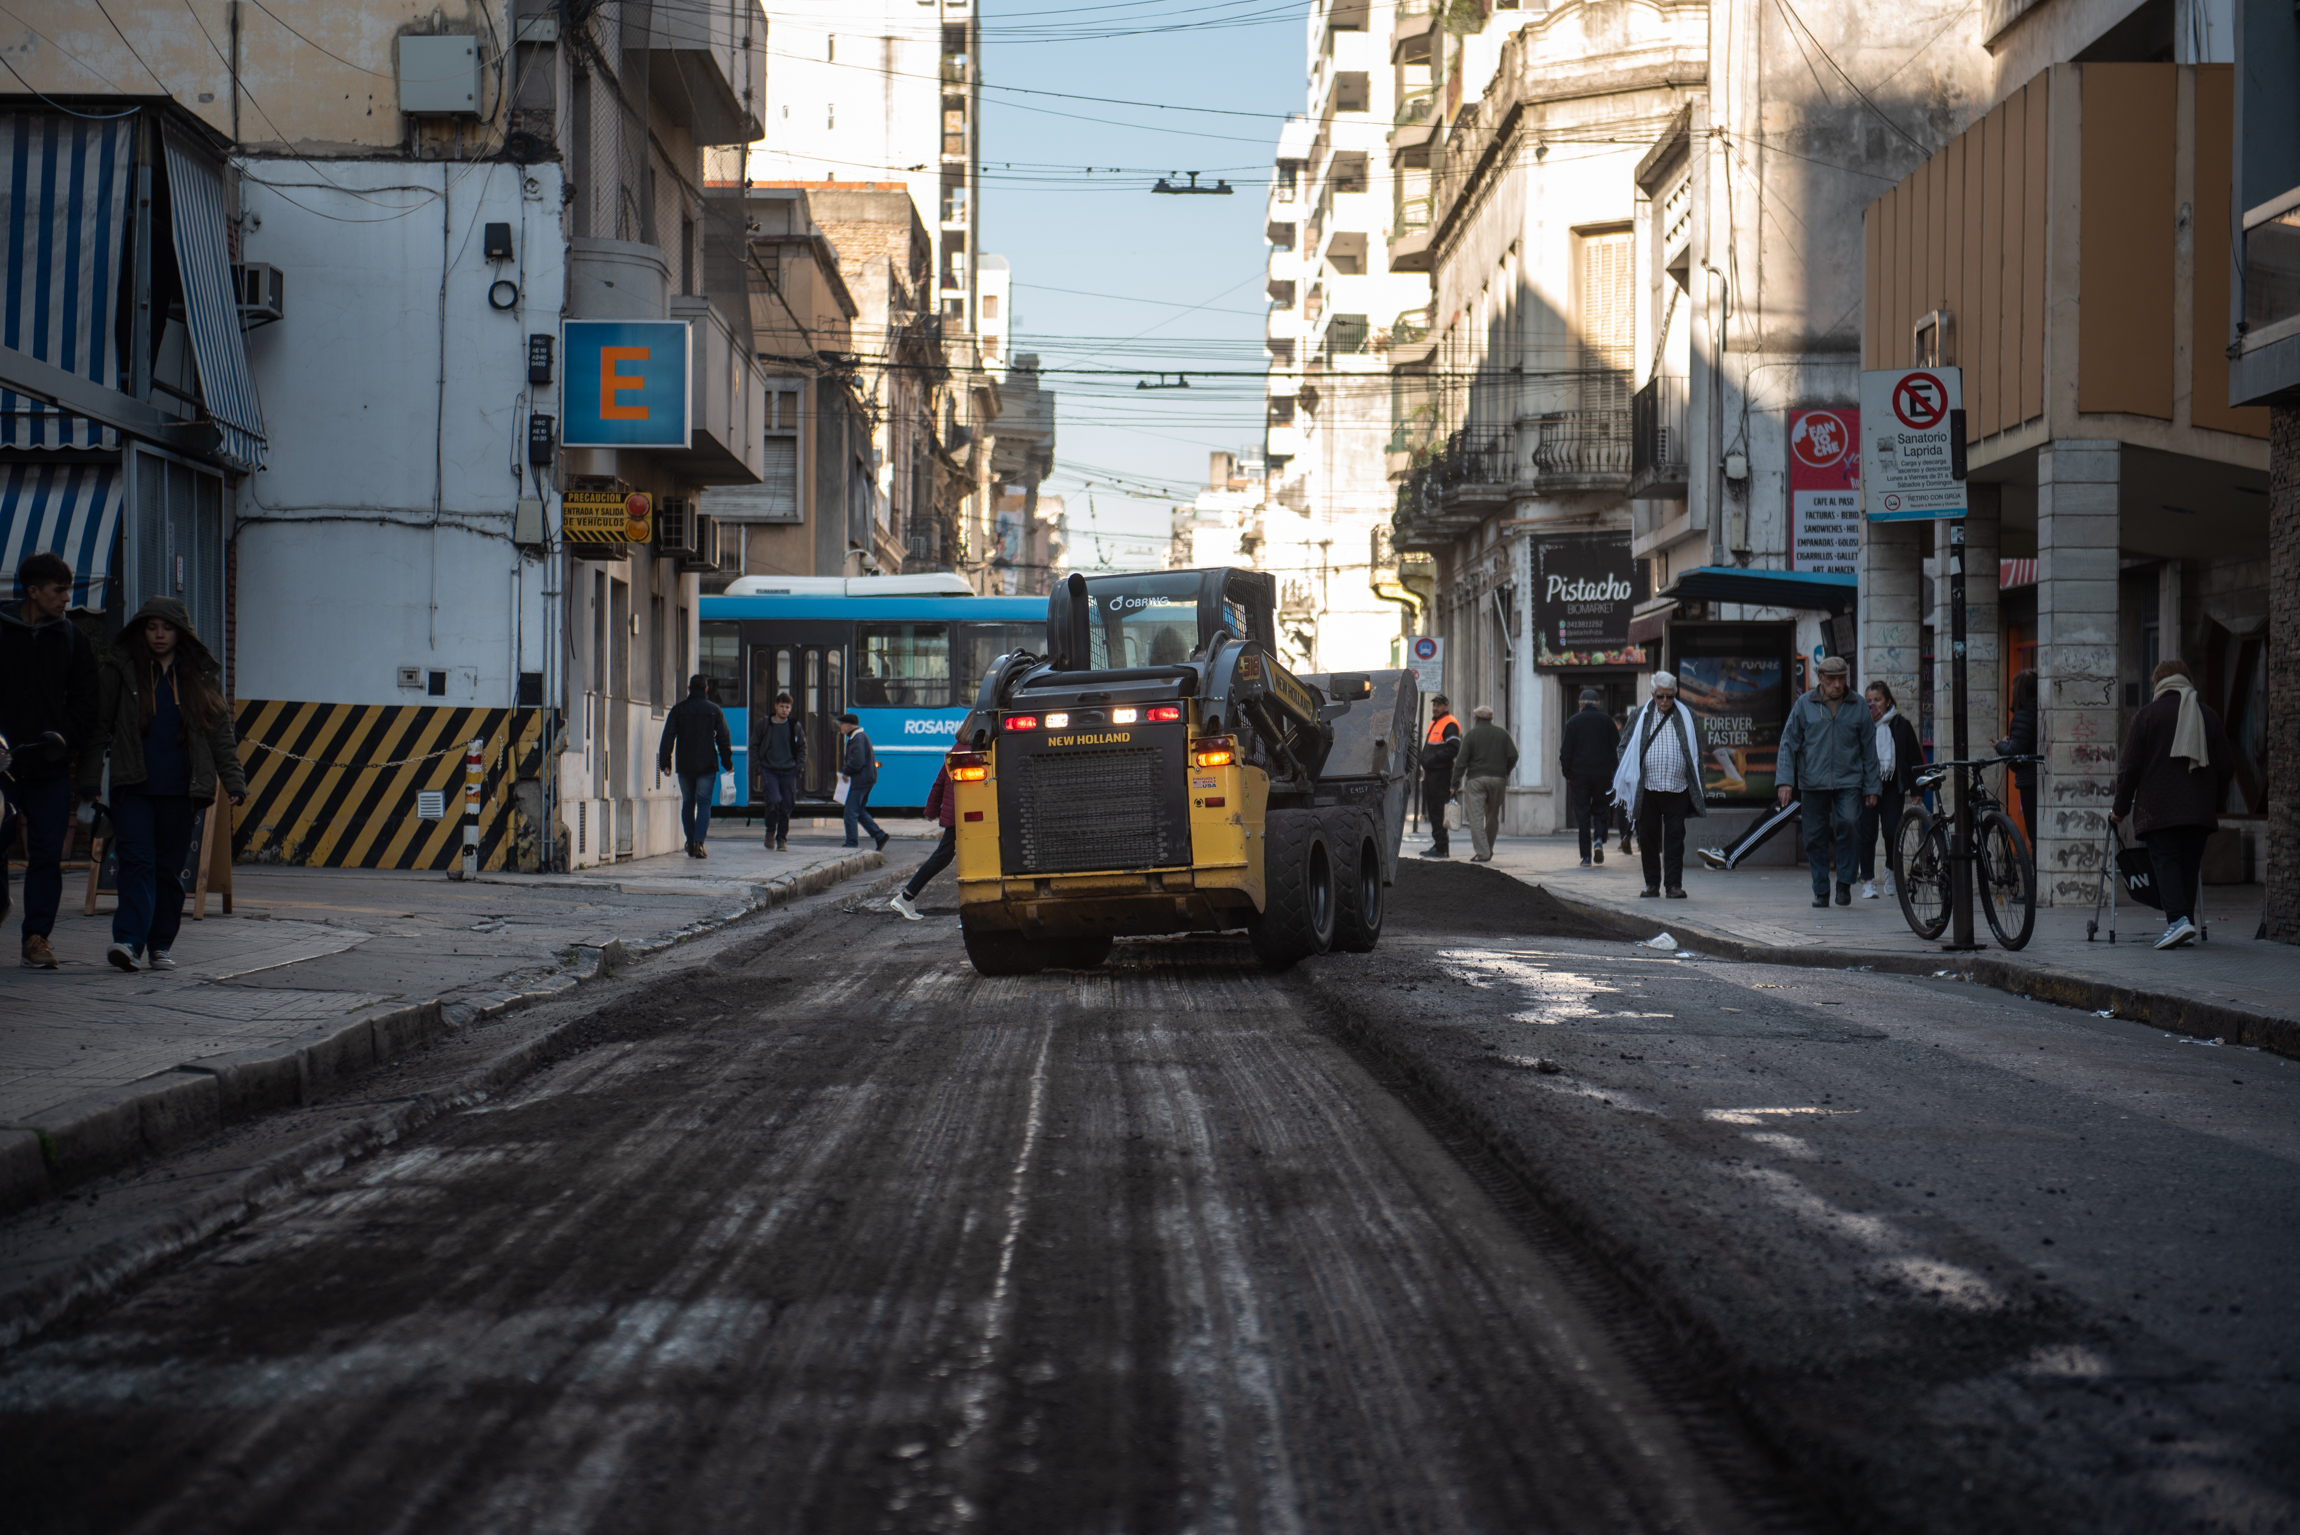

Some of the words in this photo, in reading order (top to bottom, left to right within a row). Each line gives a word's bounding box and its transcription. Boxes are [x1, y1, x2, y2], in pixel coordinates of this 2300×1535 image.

[600, 346, 650, 419] E
[1808, 421, 1837, 438] FAN
[1812, 434, 1831, 447] TO
[1898, 432, 1947, 444] Sanatorio
[1814, 441, 1840, 457] CHE
[1904, 445, 1943, 458] Laprida
[568, 493, 621, 502] PRECAUCION
[1813, 497, 1828, 506] CAFE
[1829, 497, 1837, 506] AL
[1838, 497, 1854, 506] PASO
[563, 507, 593, 516] ENTRADA
[595, 508, 600, 516] Y
[601, 508, 625, 516] SALIDA
[1805, 511, 1835, 519] FACTURAS
[563, 518, 573, 526] DE
[1804, 525, 1843, 533] SANDWICHES
[1797, 538, 1834, 547] EMPANADAS
[1796, 552, 1833, 560] CIGARRILLOS
[1827, 566, 1855, 574] ALMACEN
[1546, 572, 1632, 603] Pistacho
[1125, 596, 1170, 608] OBRING
[1567, 602, 1614, 615] BIOMARKET
[1703, 717, 1756, 731] FOREVER.
[1048, 736, 1074, 747] NEW
[1077, 732, 1131, 745] HOLLAND
[1708, 731, 1753, 745] FASTER.
